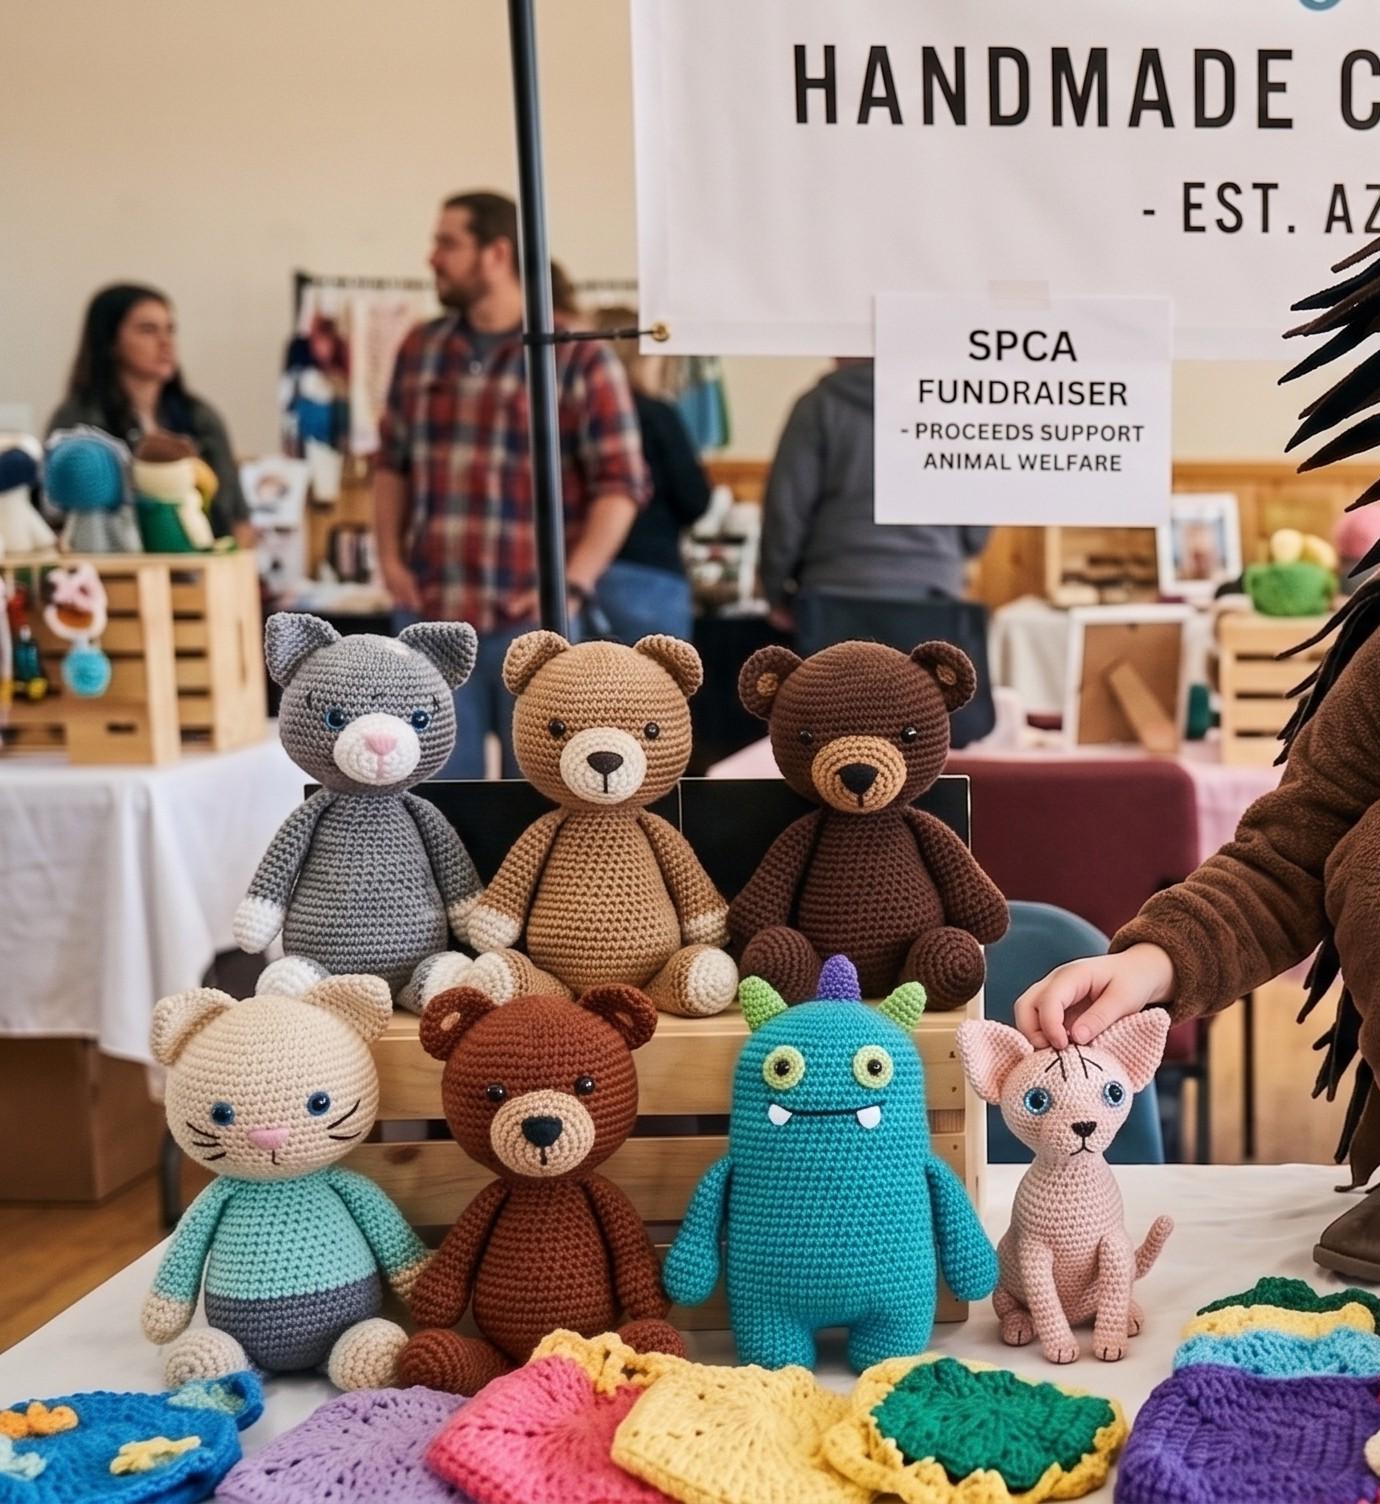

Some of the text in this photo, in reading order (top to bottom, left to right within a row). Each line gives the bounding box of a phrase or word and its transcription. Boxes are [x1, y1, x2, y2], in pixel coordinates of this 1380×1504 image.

[793, 44, 1294, 130] HANDMADE
[1183, 181, 1296, 234] EST.
[967, 329, 1078, 362] SPCA
[918, 379, 1128, 407] FUNDRAISER
[914, 422, 1034, 442] PROCEEDS
[1040, 424, 1145, 443] SUPPORT
[923, 452, 1122, 472] ANIMAL WELFARE
